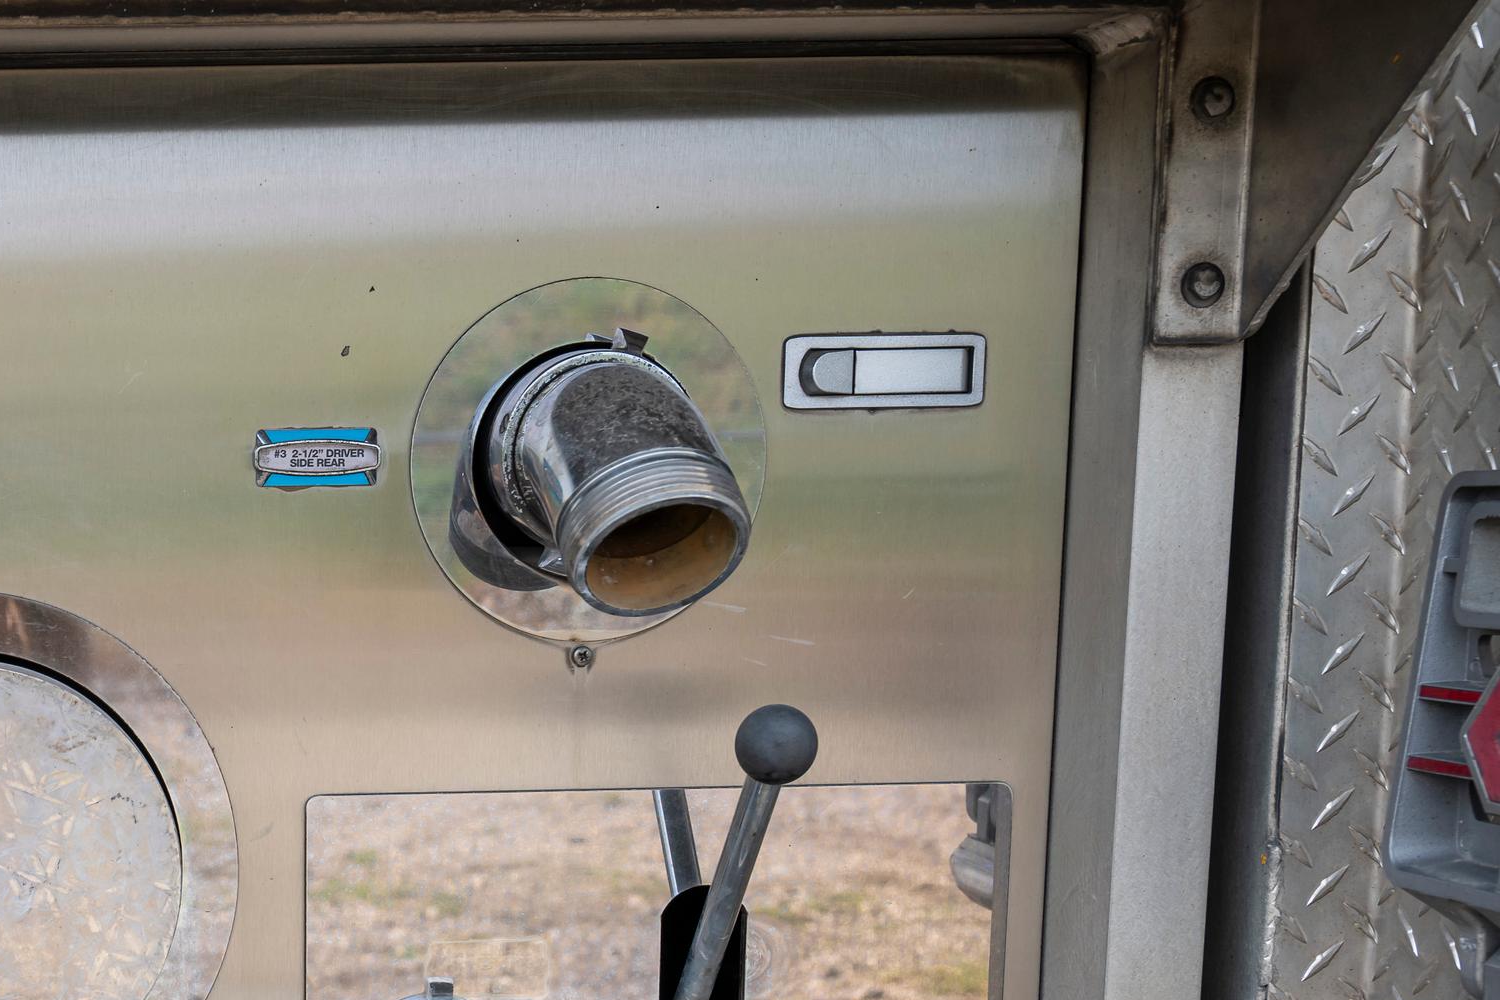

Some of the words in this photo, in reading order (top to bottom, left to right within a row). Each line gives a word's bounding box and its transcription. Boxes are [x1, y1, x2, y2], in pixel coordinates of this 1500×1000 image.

[274, 449, 287, 458] #3
[326, 448, 365, 458] DRIVER
[290, 458, 314, 468] SIDE
[316, 458, 345, 468] REAR
